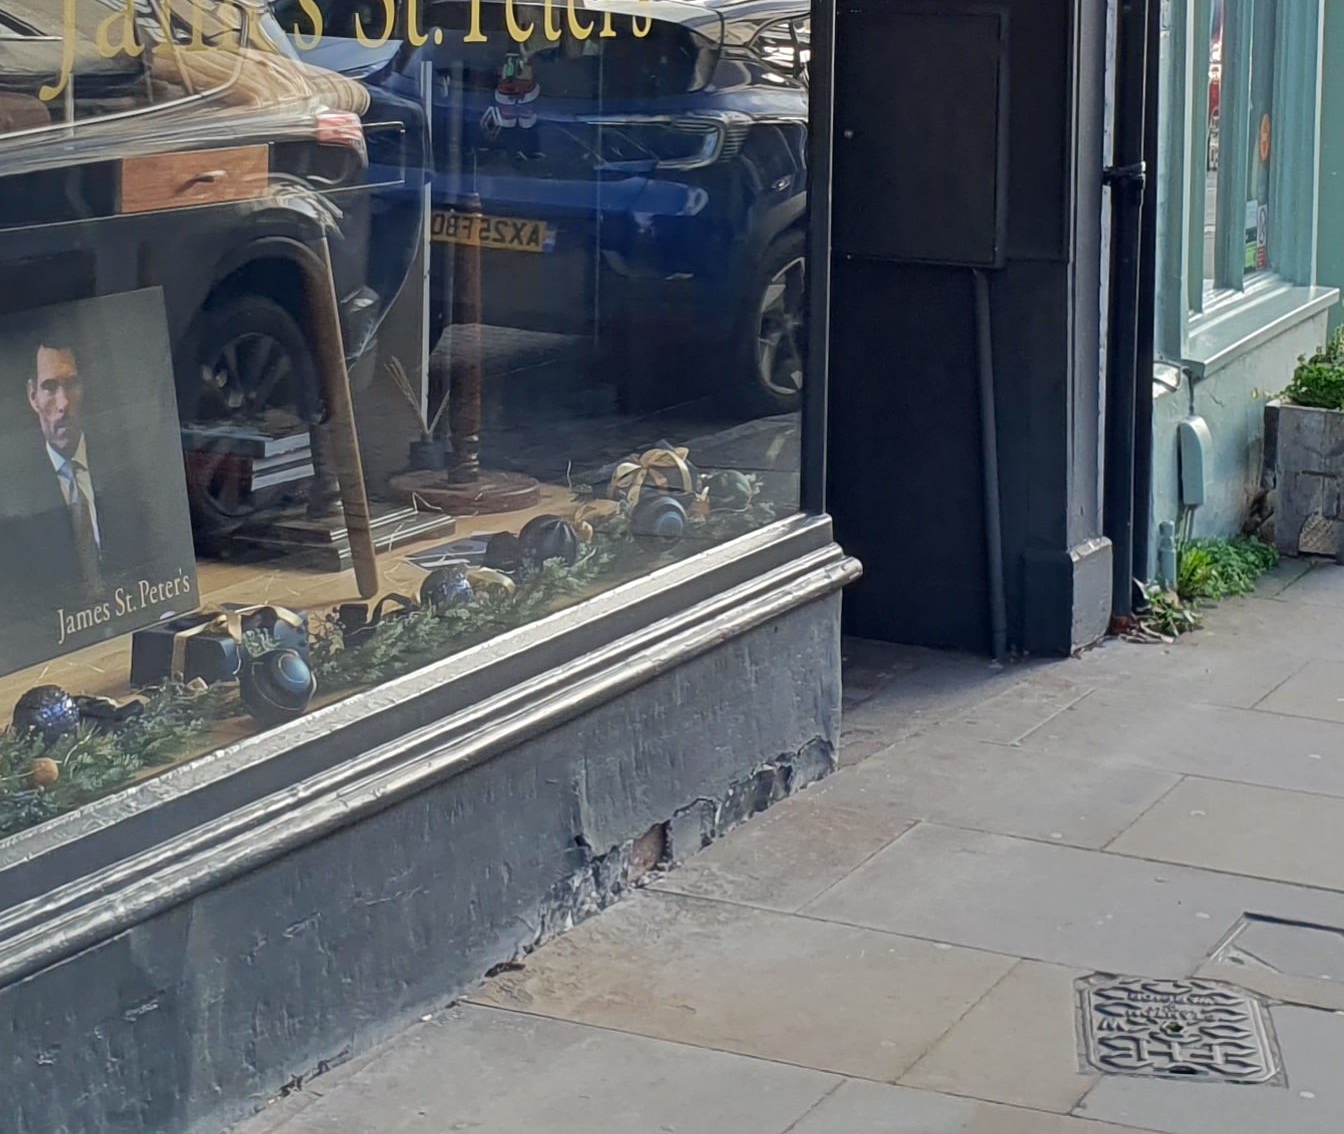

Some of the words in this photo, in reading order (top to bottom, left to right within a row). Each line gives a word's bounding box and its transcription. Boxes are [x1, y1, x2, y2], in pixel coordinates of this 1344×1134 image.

[57, 602, 111, 645] James
[115, 587, 137, 617] St.
[138, 567, 190, 608] Peter's
